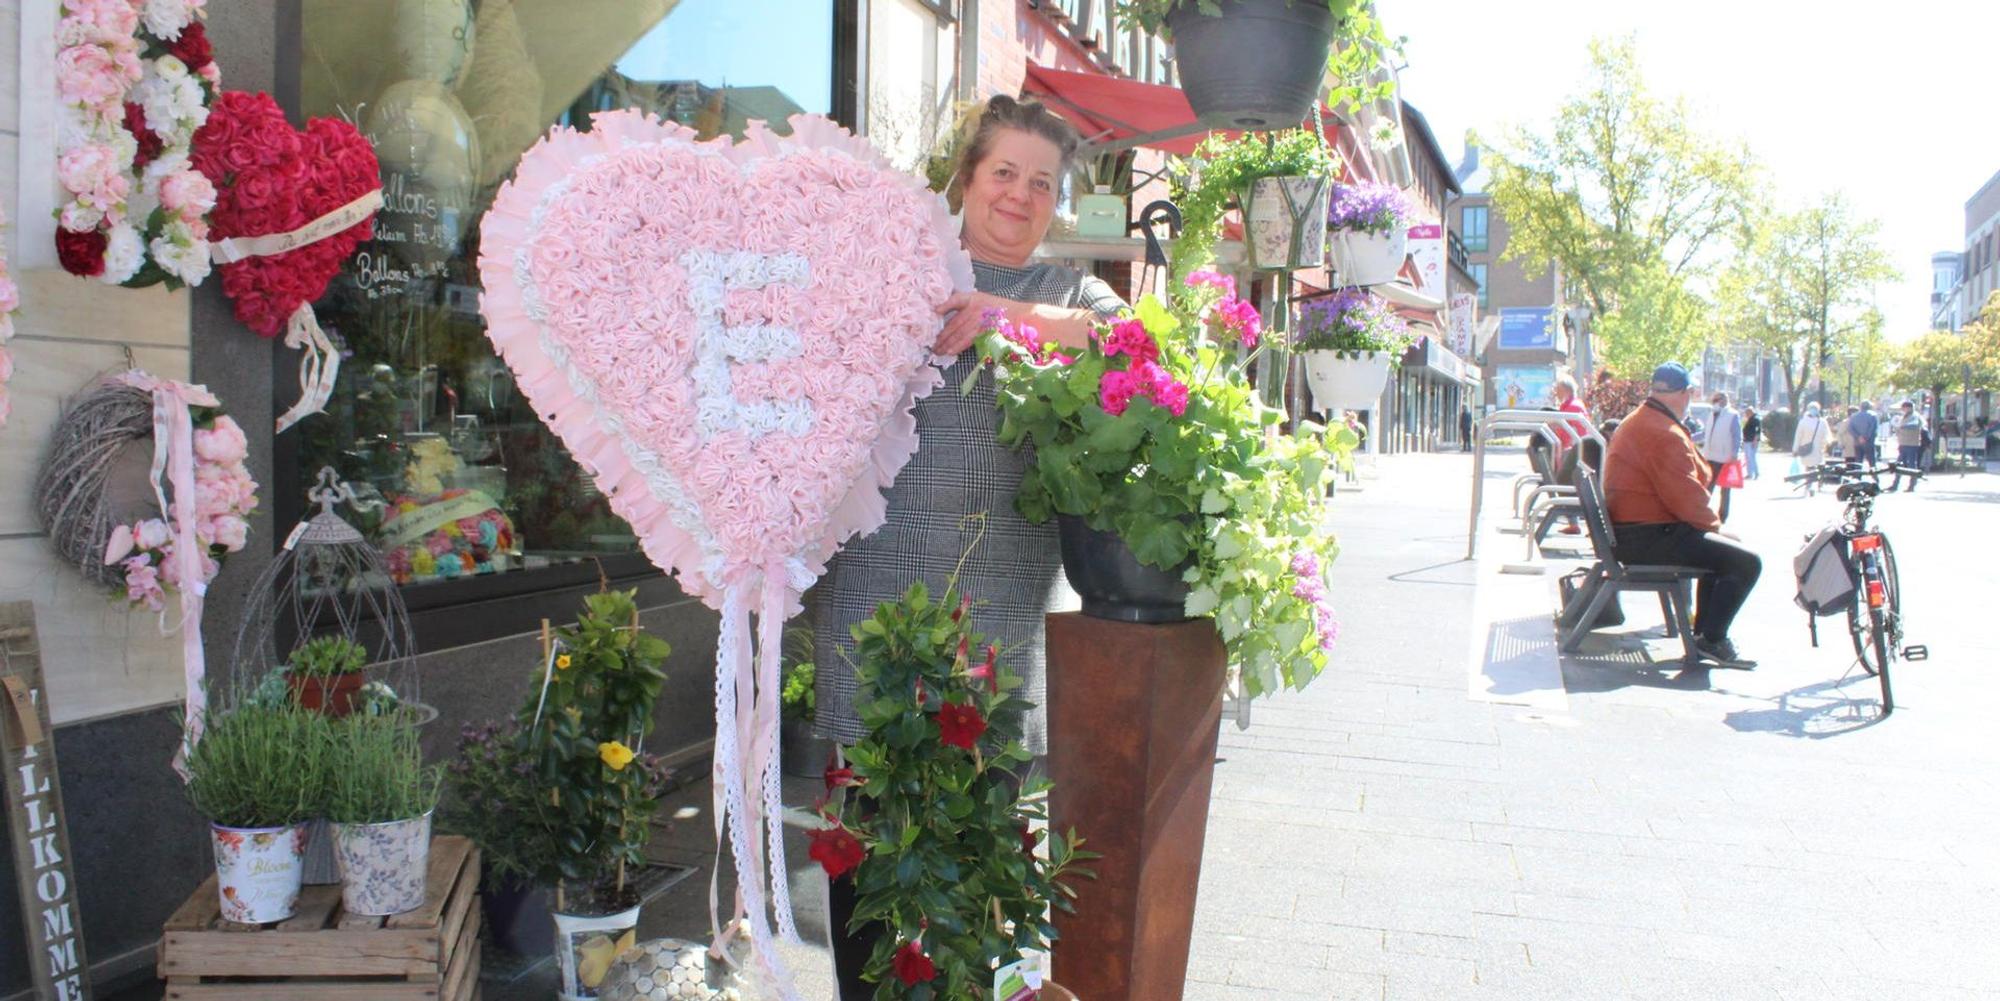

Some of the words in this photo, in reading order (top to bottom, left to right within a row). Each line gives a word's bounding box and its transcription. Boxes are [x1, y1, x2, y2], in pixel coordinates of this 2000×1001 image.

[383, 173, 438, 220] allons
[356, 252, 410, 289] Ballons
[677, 247, 815, 441] E
[18, 688, 84, 1001] LLKOMME
